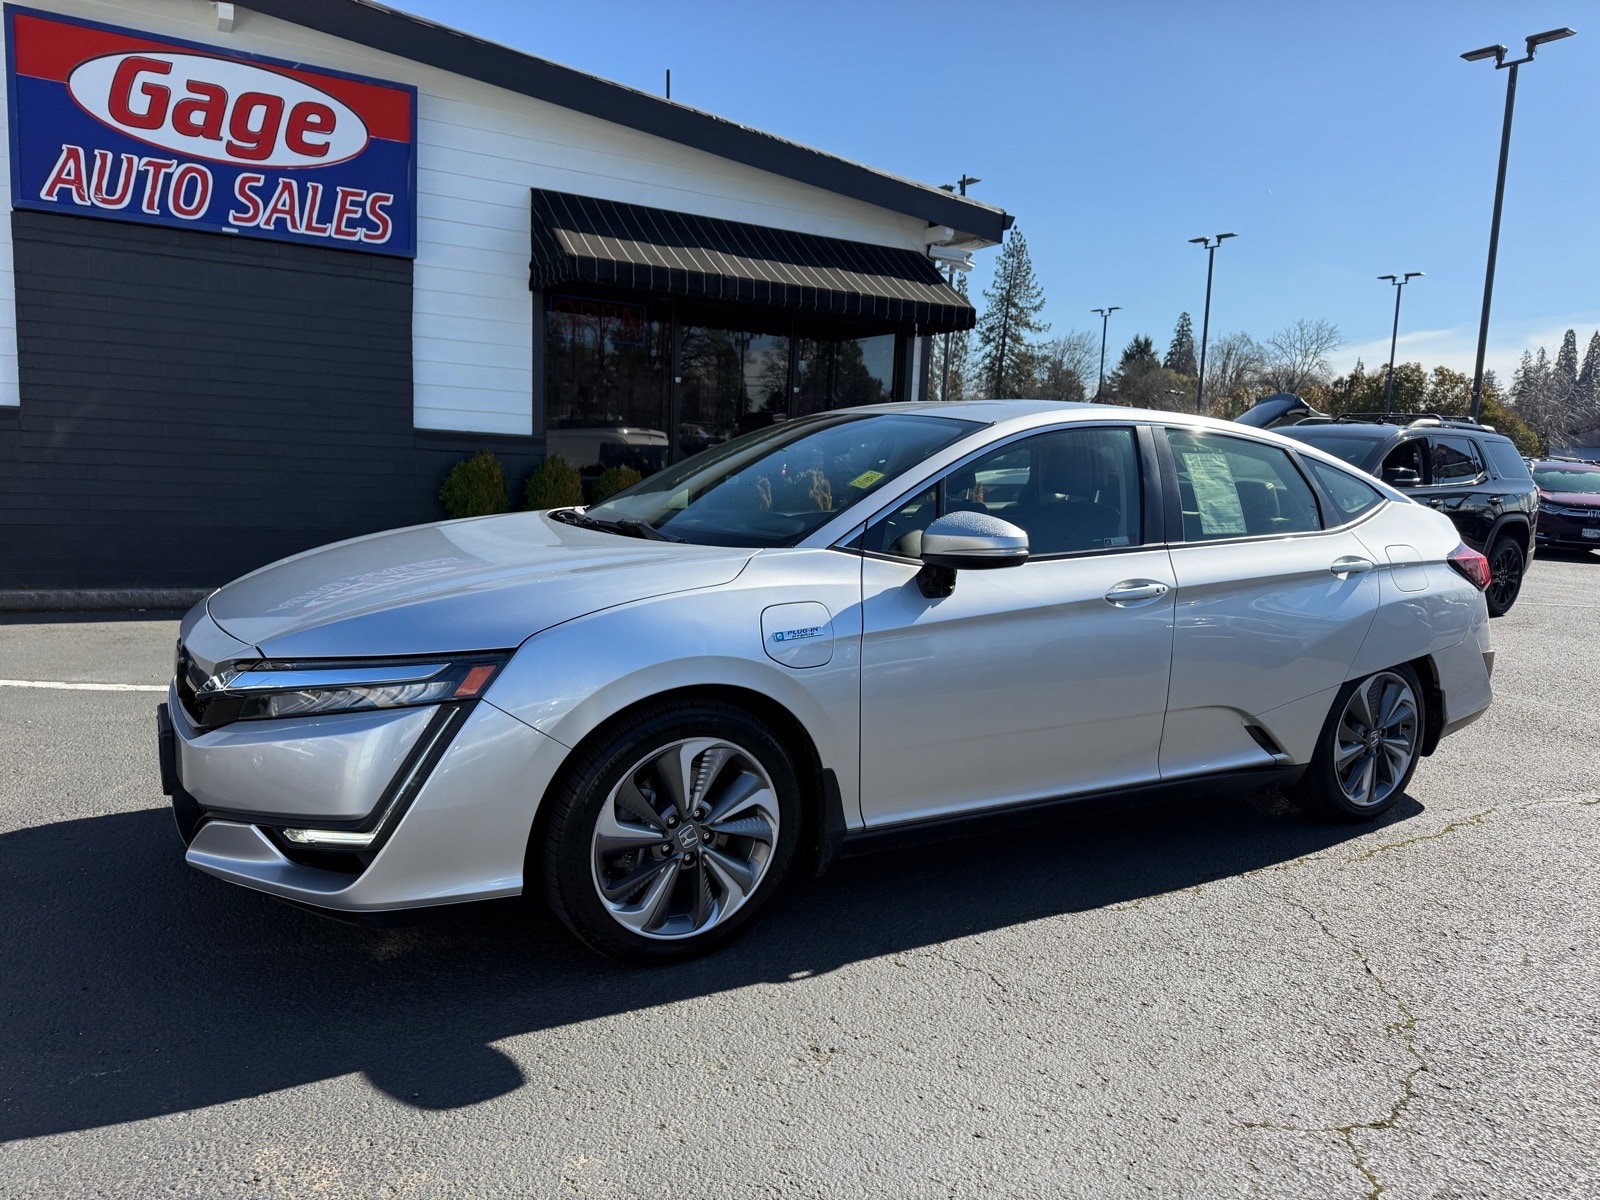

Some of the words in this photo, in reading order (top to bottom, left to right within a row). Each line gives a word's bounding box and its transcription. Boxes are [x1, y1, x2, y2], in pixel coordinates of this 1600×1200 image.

[108, 55, 337, 161] Gage
[40, 144, 213, 220] AUTO
[228, 172, 394, 244] SALES
[553, 298, 644, 341] OPEN
[787, 626, 819, 636] PLUG-IN
